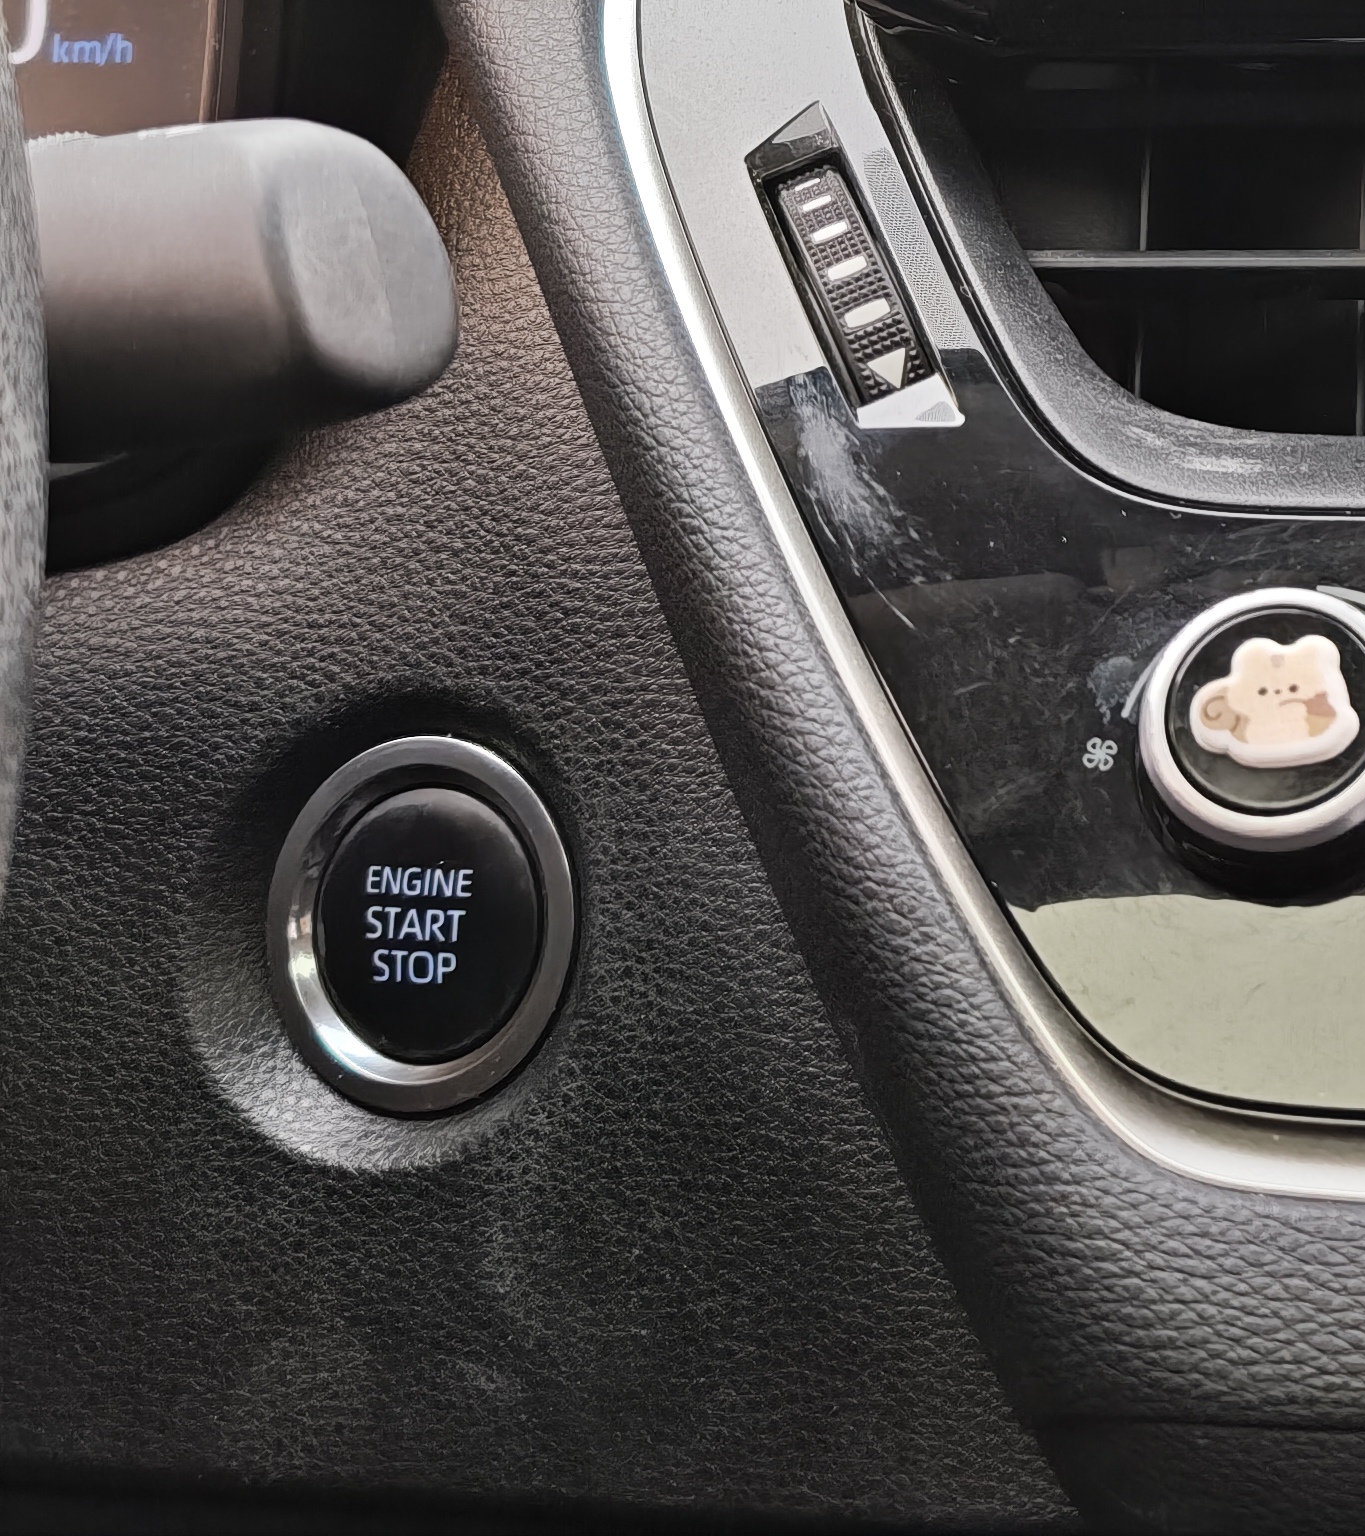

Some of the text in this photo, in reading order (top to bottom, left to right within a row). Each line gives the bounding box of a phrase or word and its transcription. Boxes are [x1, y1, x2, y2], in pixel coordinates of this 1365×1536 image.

[52, 32, 133, 66] km/h
[366, 865, 474, 898] ENGINE
[364, 905, 467, 943] START
[372, 949, 457, 984] STOP
